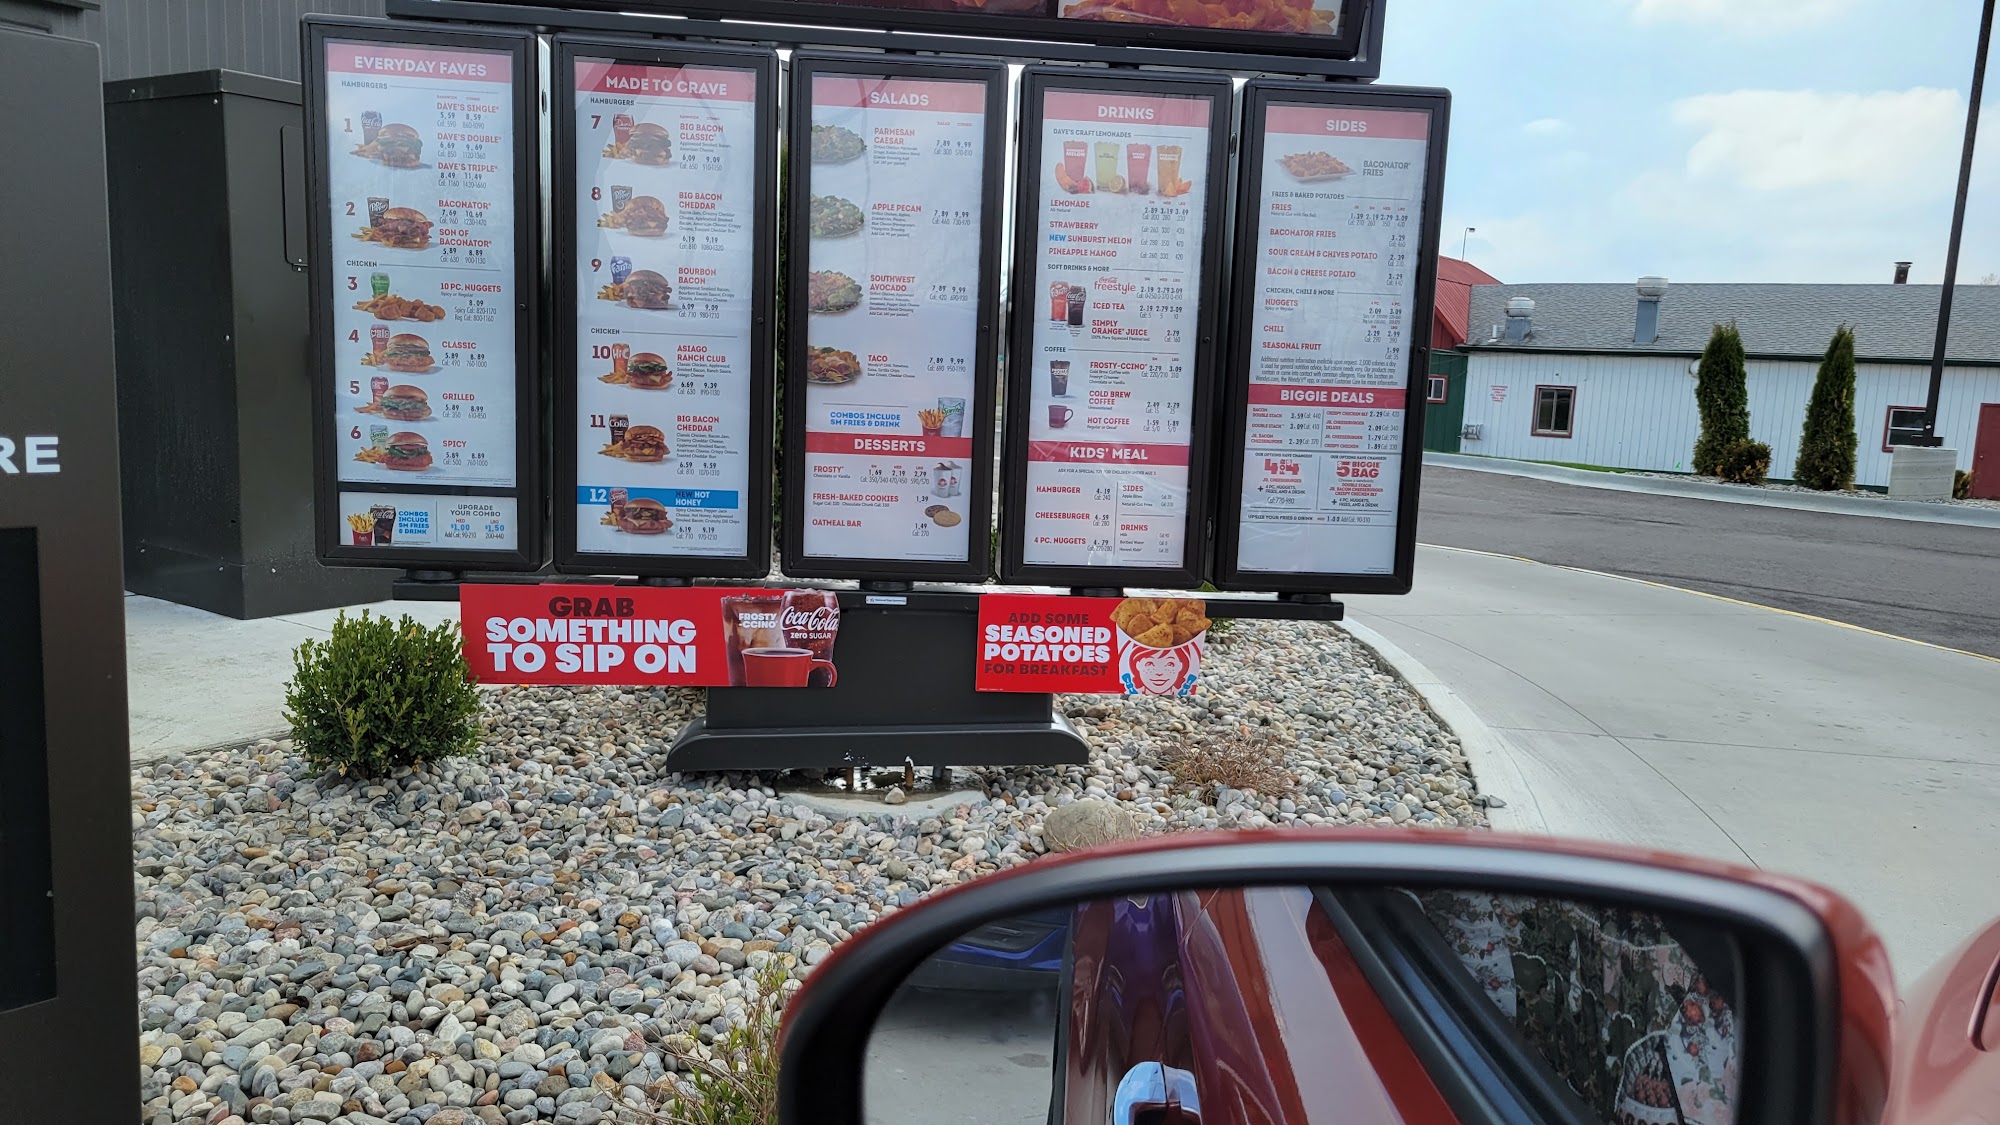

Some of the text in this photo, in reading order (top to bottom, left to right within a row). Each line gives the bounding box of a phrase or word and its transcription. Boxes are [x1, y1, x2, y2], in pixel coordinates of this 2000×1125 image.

[354, 56, 487, 76] EVERYDAY FAVES
[341, 80, 388, 89] HAMBURGERS
[606, 76, 728, 96] MADE TO CRAVE
[590, 97, 635, 106] HAMBURGERS
[870, 91, 929, 106] SALADS
[1097, 105, 1154, 120] DRINKS
[344, 118, 352, 132] 1
[590, 114, 601, 129] 7
[1326, 119, 1367, 132] SIDES
[696, 124, 724, 132] BACON
[874, 128, 915, 136] PARMESAN
[1096, 130, 1132, 138] LEMONADES
[874, 136, 905, 145] CAESAR
[591, 186, 602, 201] 8
[695, 192, 722, 200] BACON
[1315, 192, 1345, 200] POTATOES
[679, 201, 716, 210] CHEDDAR
[872, 203, 922, 212] APPLE PECAN
[1050, 200, 1090, 208] LEMONADE
[346, 202, 356, 216] 2
[1049, 221, 1099, 229] STRAWBERRY
[1270, 228, 1336, 238] BACONATOR FRIES
[1049, 234, 1066, 242] NEW
[1067, 235, 1106, 243] SUNBURST
[1048, 247, 1117, 257] PINEAPPLE MANGO
[1268, 248, 1288, 256] SOUR
[1351, 252, 1378, 260] POTATO
[591, 258, 602, 272] 9
[678, 268, 717, 276] BOURBON
[1267, 267, 1293, 276] BACON
[1300, 269, 1327, 277] CHEESE
[1329, 270, 1356, 278] POTATO
[348, 276, 358, 290] 3
[678, 276, 706, 284] BACON
[870, 274, 916, 283] SOUTHWEST
[440, 282, 502, 292] 10 PC. NUGGETS
[1094, 281, 1136, 294] freestyle
[1092, 302, 1110, 310] ICED
[1265, 298, 1298, 306] NUGGETS
[348, 329, 360, 343] 4
[442, 341, 476, 350] CLASSIC
[676, 345, 708, 353] ASIAGO
[1262, 342, 1300, 350] SEASONAL
[592, 345, 610, 359] 10
[677, 354, 704, 362] RANCH
[350, 380, 360, 394] 5
[1089, 390, 1109, 398] COLD
[1280, 390, 1374, 404] BIGGIE DEALS
[590, 414, 606, 428] 11
[676, 415, 690, 423] BIG
[866, 413, 901, 421] INCLUDE
[676, 424, 713, 432] CHEDDAR
[350, 426, 361, 440] 6
[442, 440, 466, 448] SPICY
[854, 438, 926, 452] DESSERTS
[1070, 446, 1148, 460] KIDS' MEAL
[1351, 469, 1380, 478] BAG
[1036, 486, 1081, 494] HAMBURGER
[590, 488, 607, 503] 12
[812, 493, 864, 501] FRESH-BAKED
[1035, 512, 1090, 520] CHEESEBURGER
[812, 519, 846, 527] OATMEAL
[1120, 524, 1148, 532] DRINKS
[548, 596, 634, 618] GRAB
[738, 612, 777, 621] FROSTY
[1008, 613, 1089, 625] ADD SOME
[485, 617, 696, 643] SOMETHING
[985, 624, 1111, 644] SEASONED
[790, 632, 831, 640] zero SUGAR
[984, 643, 1111, 663] POTATOES
[486, 643, 696, 674] TO SIP ON
[984, 664, 1109, 676] FOR BREAKFAST
